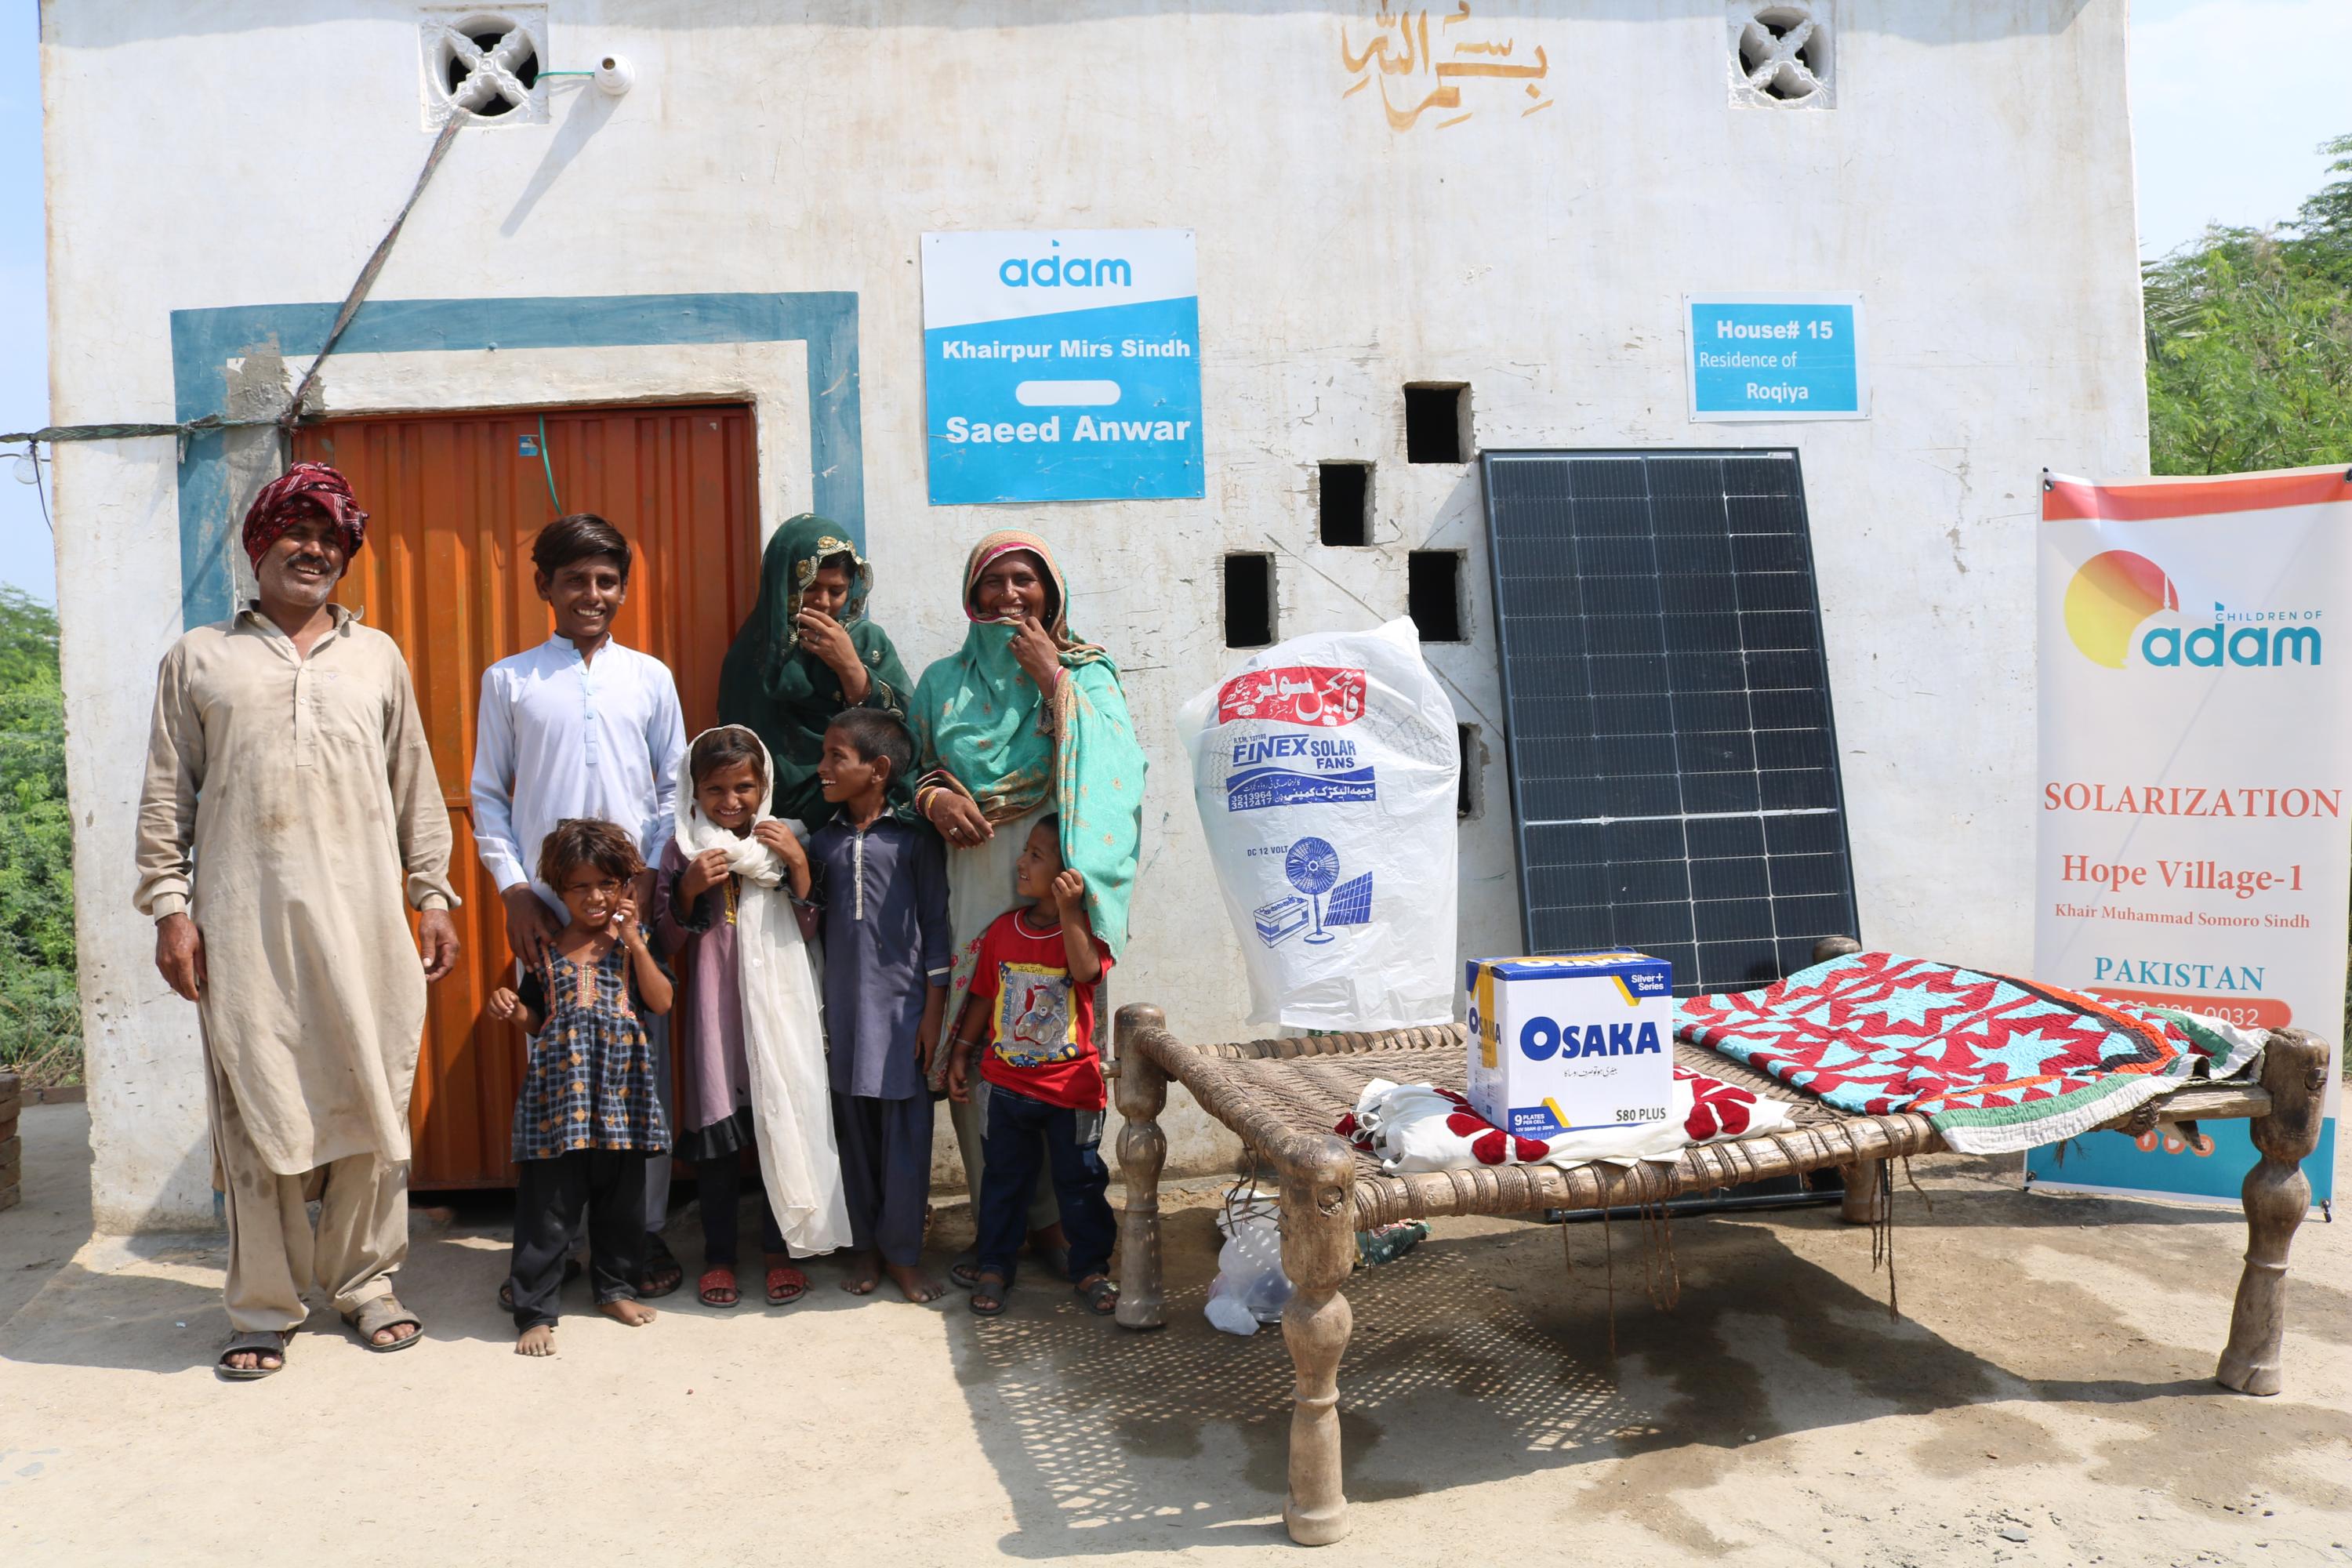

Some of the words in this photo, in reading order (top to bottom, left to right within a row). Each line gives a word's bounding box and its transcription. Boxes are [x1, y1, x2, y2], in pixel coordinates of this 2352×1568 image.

[999, 239, 1131, 287] adam
[1717, 320, 1800, 339] House#
[1807, 321, 1833, 339] 15
[942, 340, 1052, 362] Khairpur
[1060, 339, 1112, 358] Mirs
[1121, 339, 1190, 357] Sindh
[1700, 351, 1777, 367] Residence
[1781, 351, 1797, 367] of
[1747, 383, 1809, 403] Roqiya
[946, 416, 1059, 444] Saeed
[1073, 415, 1191, 441] Anwar
[2216, 611, 2297, 622] CHILDREN
[2303, 610, 2324, 620] OF
[2142, 601, 2321, 667] adam
[1232, 734, 1310, 768] FINEX
[1310, 739, 1356, 757] SOLAR
[1316, 757, 1355, 769] FANS
[1232, 790, 1272, 803] 3513964
[1232, 798, 1272, 810] 3512417
[2044, 782, 2343, 818] SOLARIZATION
[1270, 845, 1289, 854] VOLT
[2061, 855, 2147, 892] Hope
[2156, 861, 2303, 899] Village-1
[2055, 903, 2098, 918] Khair
[2101, 906, 2194, 925] Muhammad
[2198, 912, 2259, 927] Somoro
[2264, 913, 2310, 928] Sindh
[1631, 973, 1664, 984] Silver+
[2094, 957, 2266, 991] PAKISTAN
[1519, 1016, 1661, 1061] OSAKA
[1514, 1114, 1523, 1126] 9
[1616, 1109, 1636, 1122] S80
[1639, 1107, 1666, 1121] PLUS
